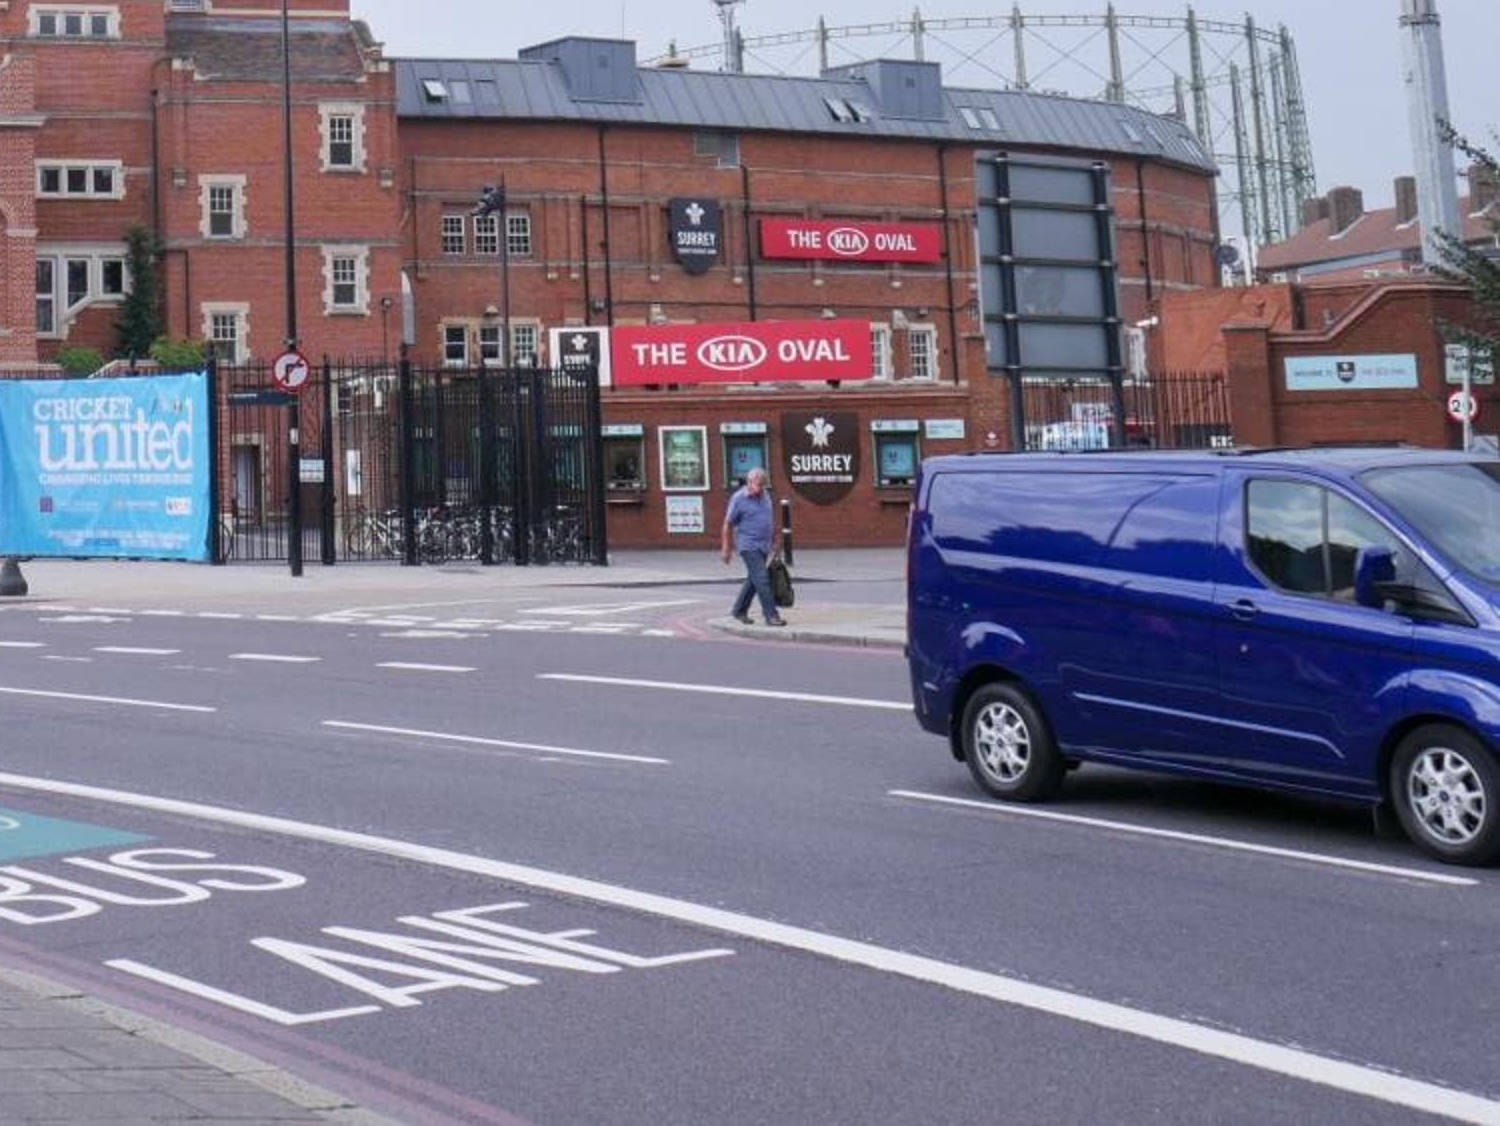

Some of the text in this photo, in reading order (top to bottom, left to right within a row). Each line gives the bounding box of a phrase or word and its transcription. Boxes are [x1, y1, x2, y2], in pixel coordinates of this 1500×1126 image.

[787, 229, 917, 251] THE KIA OVAL
[631, 338, 851, 366] THE KIA OVAL
[33, 396, 133, 421] CRICKET
[34, 395, 195, 471] united
[791, 455, 852, 473] SURREY
[103, 902, 737, 1025] LANE
